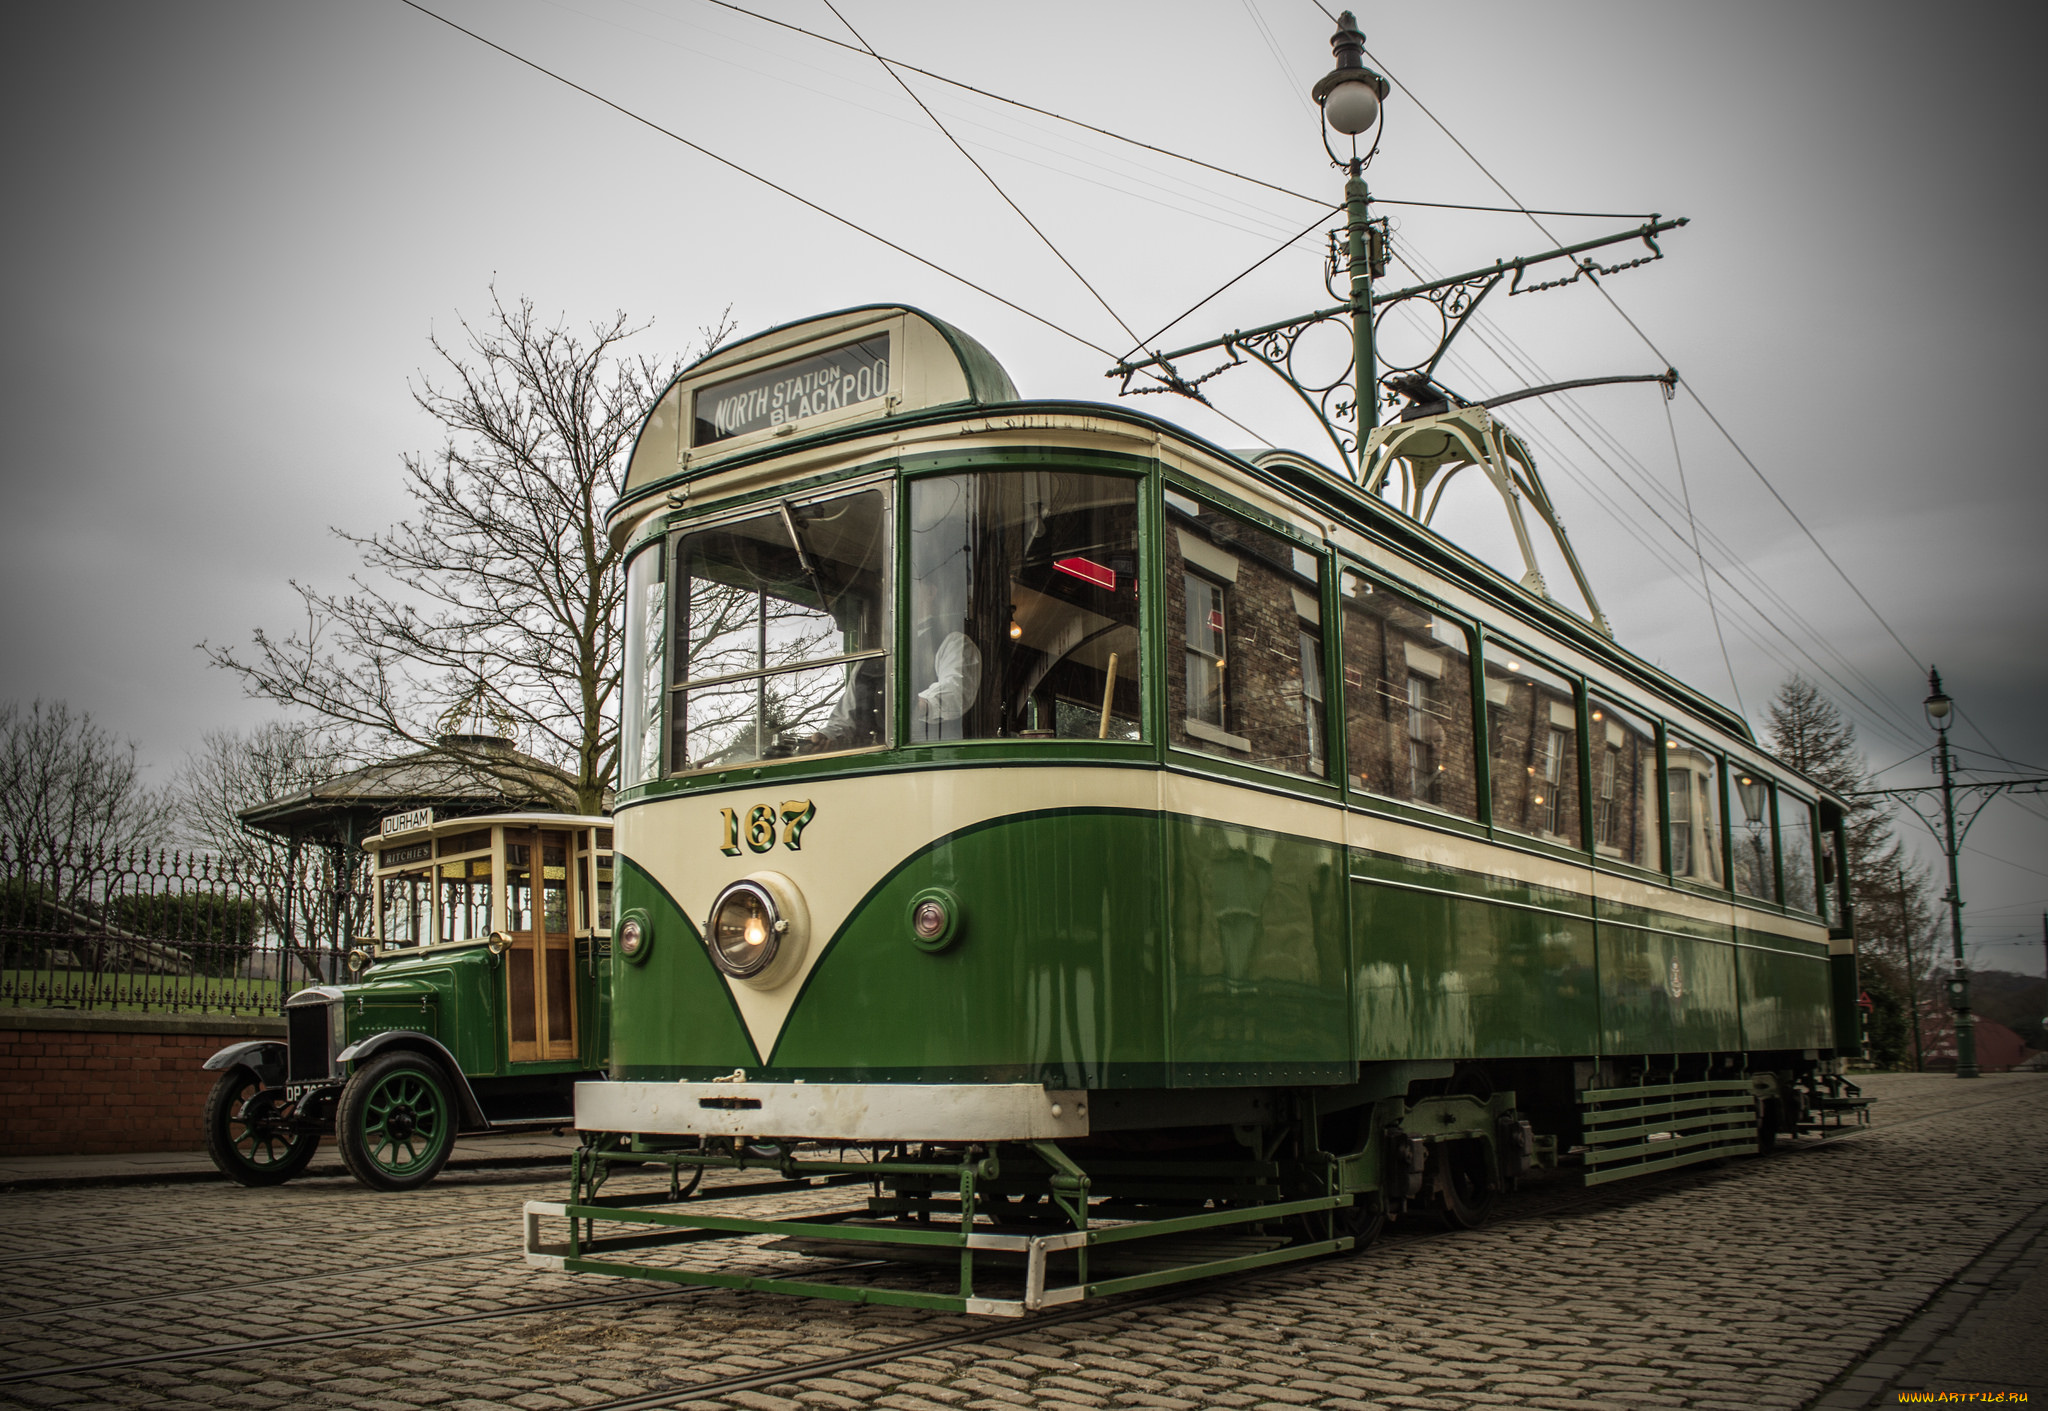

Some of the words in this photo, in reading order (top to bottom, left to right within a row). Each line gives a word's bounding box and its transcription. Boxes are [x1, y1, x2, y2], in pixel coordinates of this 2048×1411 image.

[715, 386, 769, 437] NORTH
[772, 365, 840, 408] STATION
[385, 809, 428, 833] DURHAM
[720, 799, 816, 856] 167
